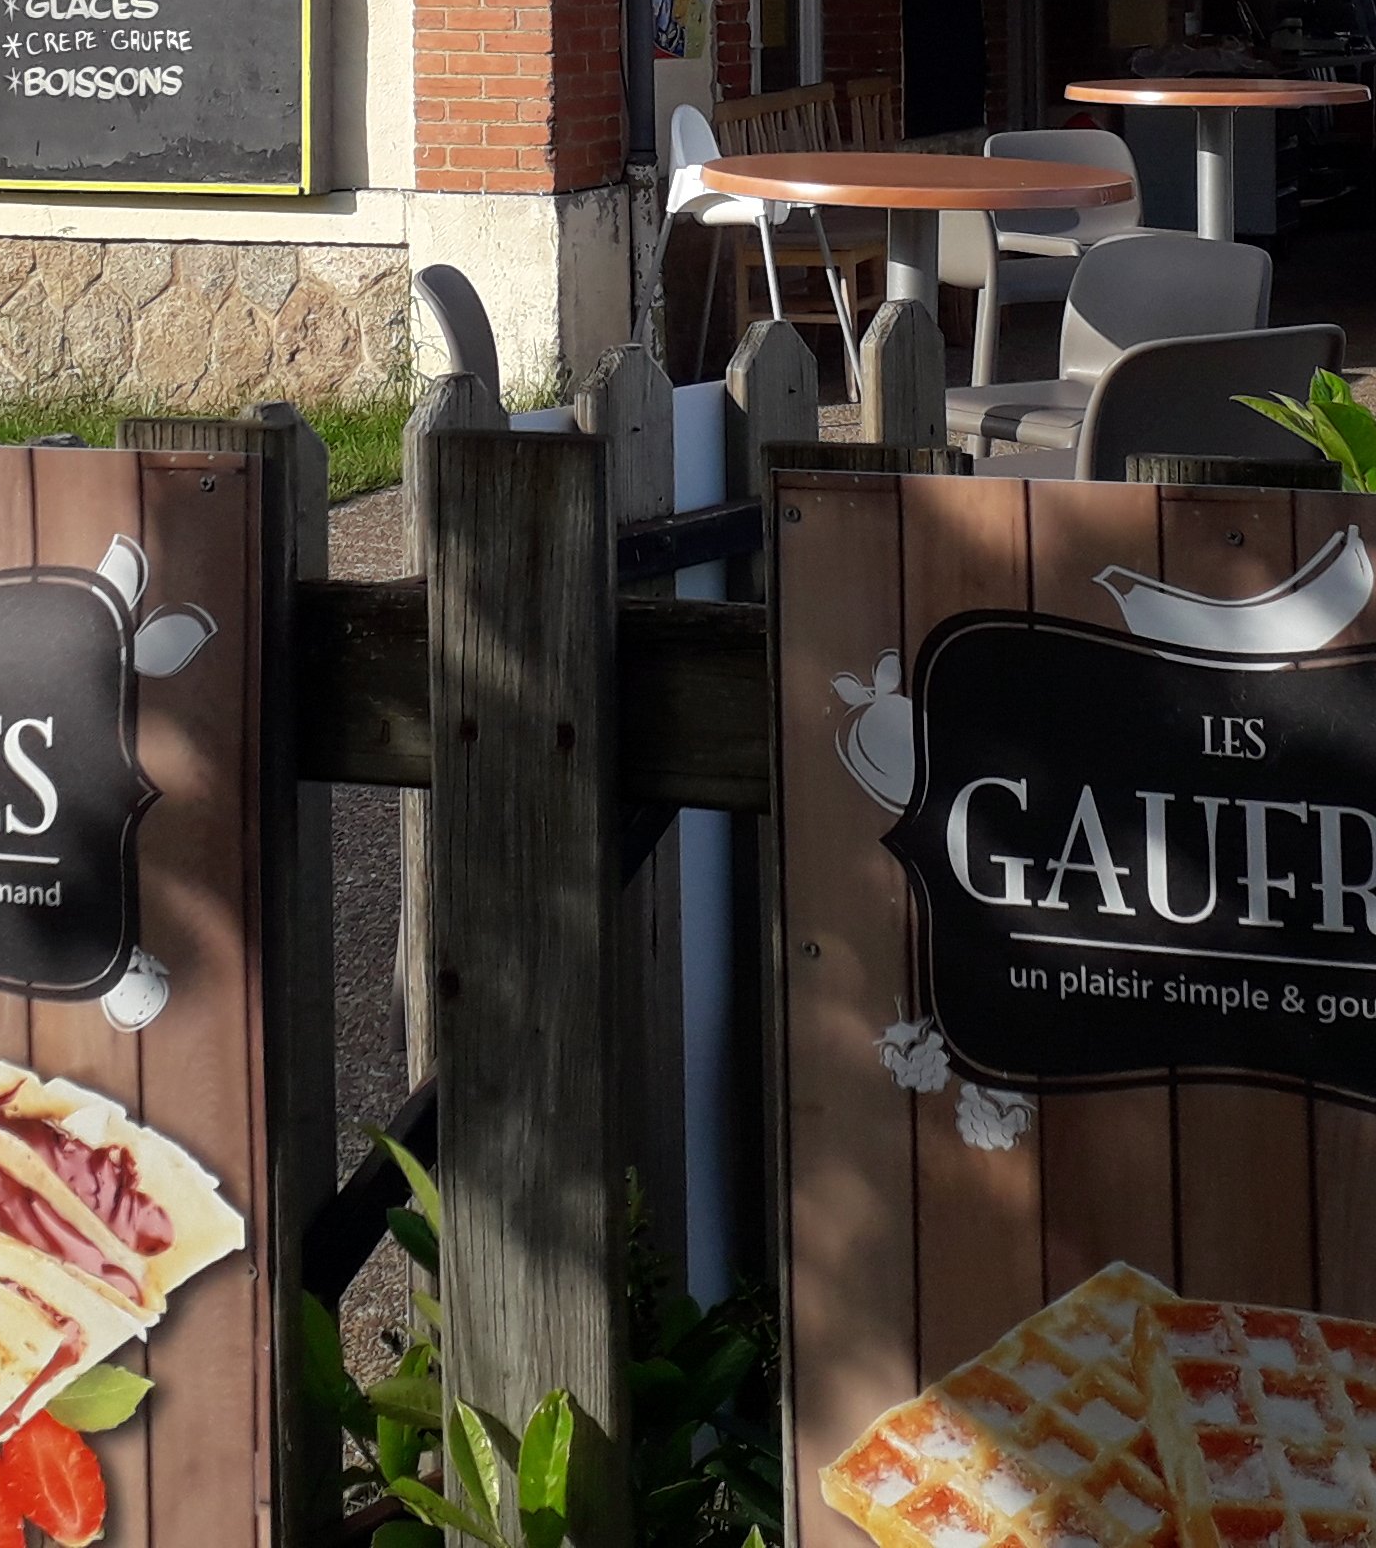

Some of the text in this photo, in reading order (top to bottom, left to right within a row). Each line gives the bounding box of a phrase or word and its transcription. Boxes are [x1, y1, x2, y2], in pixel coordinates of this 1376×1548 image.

[26, 29, 193, 56] CREPE GAUFRE
[23, 65, 184, 100] BOISSONS
[1201, 715, 1267, 760] LES
[1008, 965, 1048, 990] un
[1059, 964, 1153, 1001] plaisir
[1162, 974, 1270, 1015] simple
[1280, 984, 1306, 1014] &
